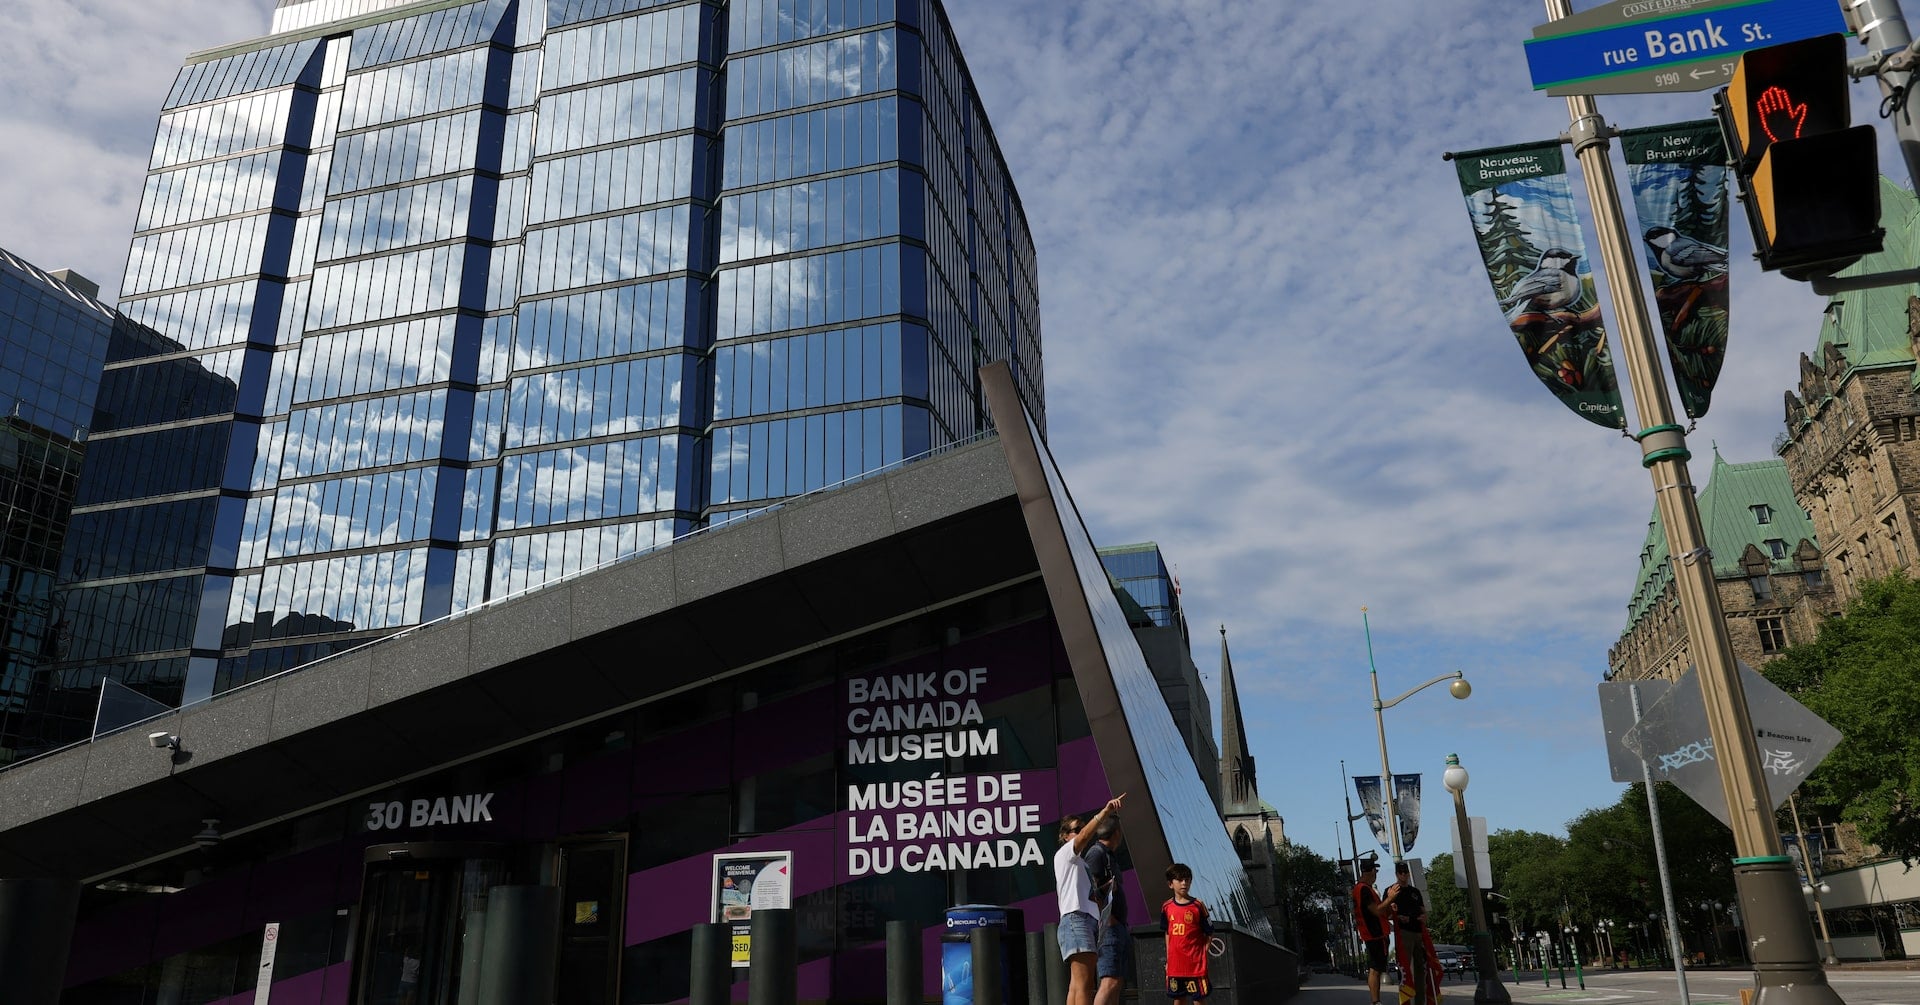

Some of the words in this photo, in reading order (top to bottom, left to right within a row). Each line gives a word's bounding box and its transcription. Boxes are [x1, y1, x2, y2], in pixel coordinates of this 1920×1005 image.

[1622, 0, 1698, 18] CONFEDER
[1603, 46, 1639, 67] rue
[1644, 17, 1729, 59] Bank
[1741, 22, 1773, 43] St.
[1655, 72, 1680, 87] 9190
[1721, 62, 1735, 76] 57
[1646, 144, 1710, 160] Brunswick
[1662, 135, 1691, 147] New
[1479, 155, 1539, 169] Nouveau-
[1479, 163, 1544, 180] Brunswick
[848, 671, 938, 703] BANK
[943, 667, 988, 696] OF
[847, 698, 984, 734] CANADA
[848, 728, 999, 765] MUSEUM
[1767, 731, 1795, 741] Beacon
[848, 772, 968, 811] MUSÉE
[976, 773, 1023, 803] DE
[367, 801, 404, 831] 30
[409, 792, 495, 828] BANK
[848, 814, 890, 843] LA
[896, 804, 1041, 841] BANQUE
[725, 864, 751, 872] WELCOME
[848, 846, 895, 876] DU
[899, 838, 1045, 873] CANADA
[1172, 923, 1186, 936] 20
